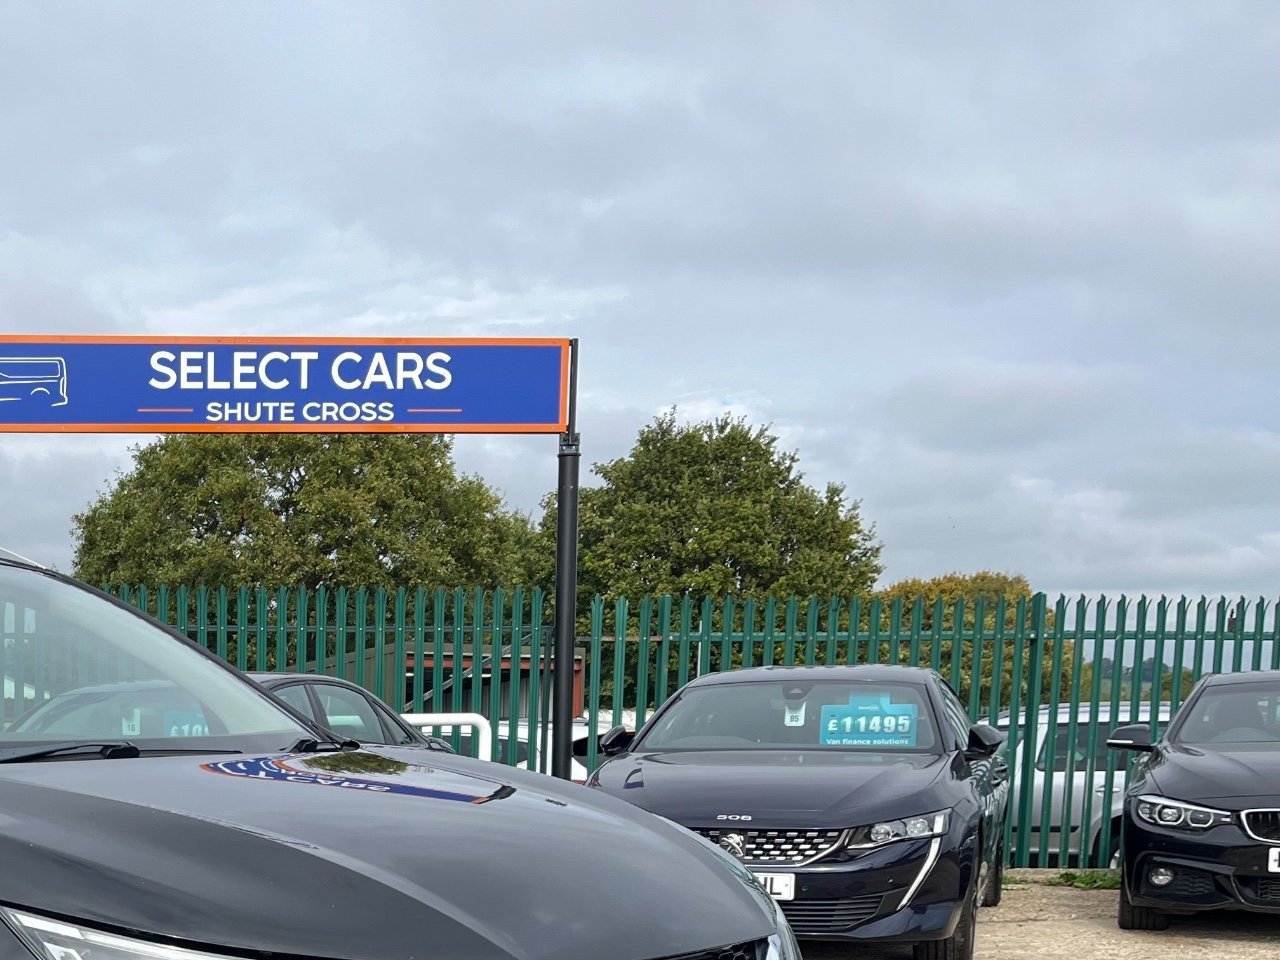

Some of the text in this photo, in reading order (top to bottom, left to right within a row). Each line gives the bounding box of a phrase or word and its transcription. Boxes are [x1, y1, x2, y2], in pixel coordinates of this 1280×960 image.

[148, 350, 452, 391] SELECT CARS
[206, 401, 395, 422] SHUTE CROSS
[827, 715, 912, 733] £11495
